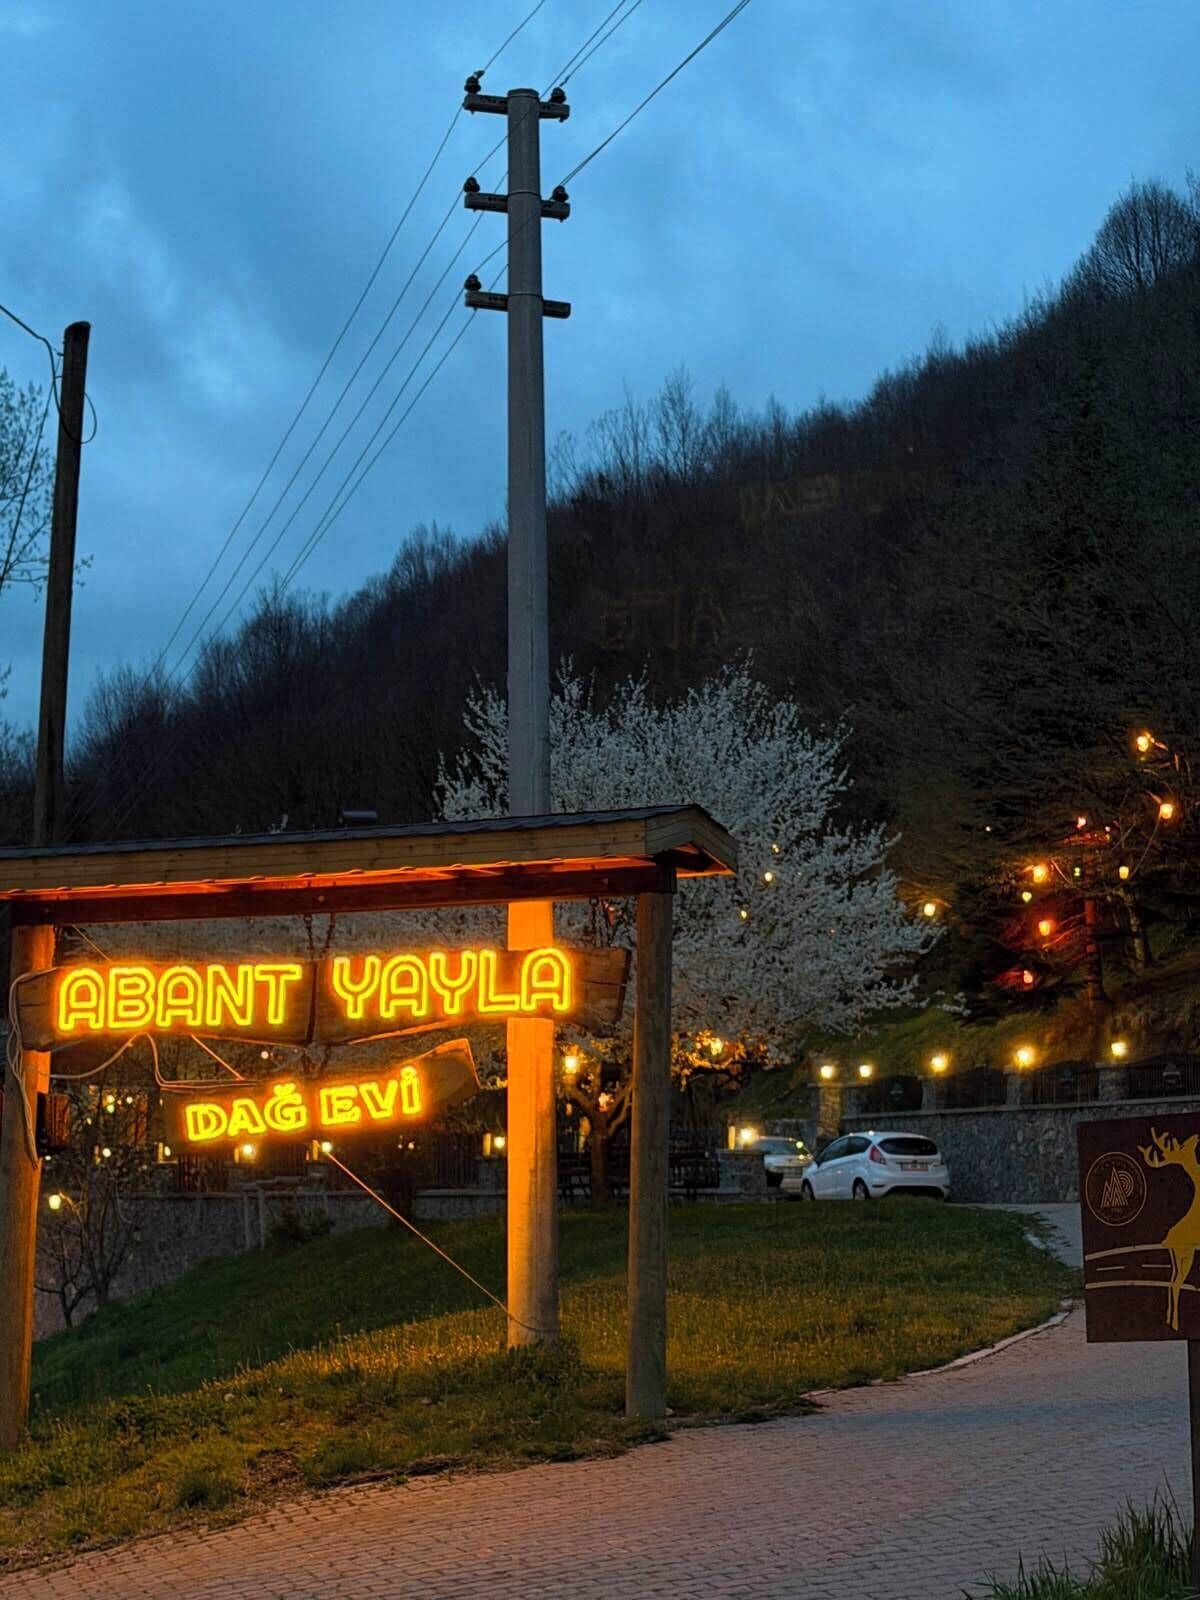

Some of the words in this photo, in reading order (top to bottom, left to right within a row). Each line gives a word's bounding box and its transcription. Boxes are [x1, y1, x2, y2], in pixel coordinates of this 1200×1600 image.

[58, 963, 302, 1030] ABANT
[332, 947, 572, 1019] YAYLA
[185, 1082, 307, 1142] DAĞ
[320, 1065, 423, 1125] EVİ
